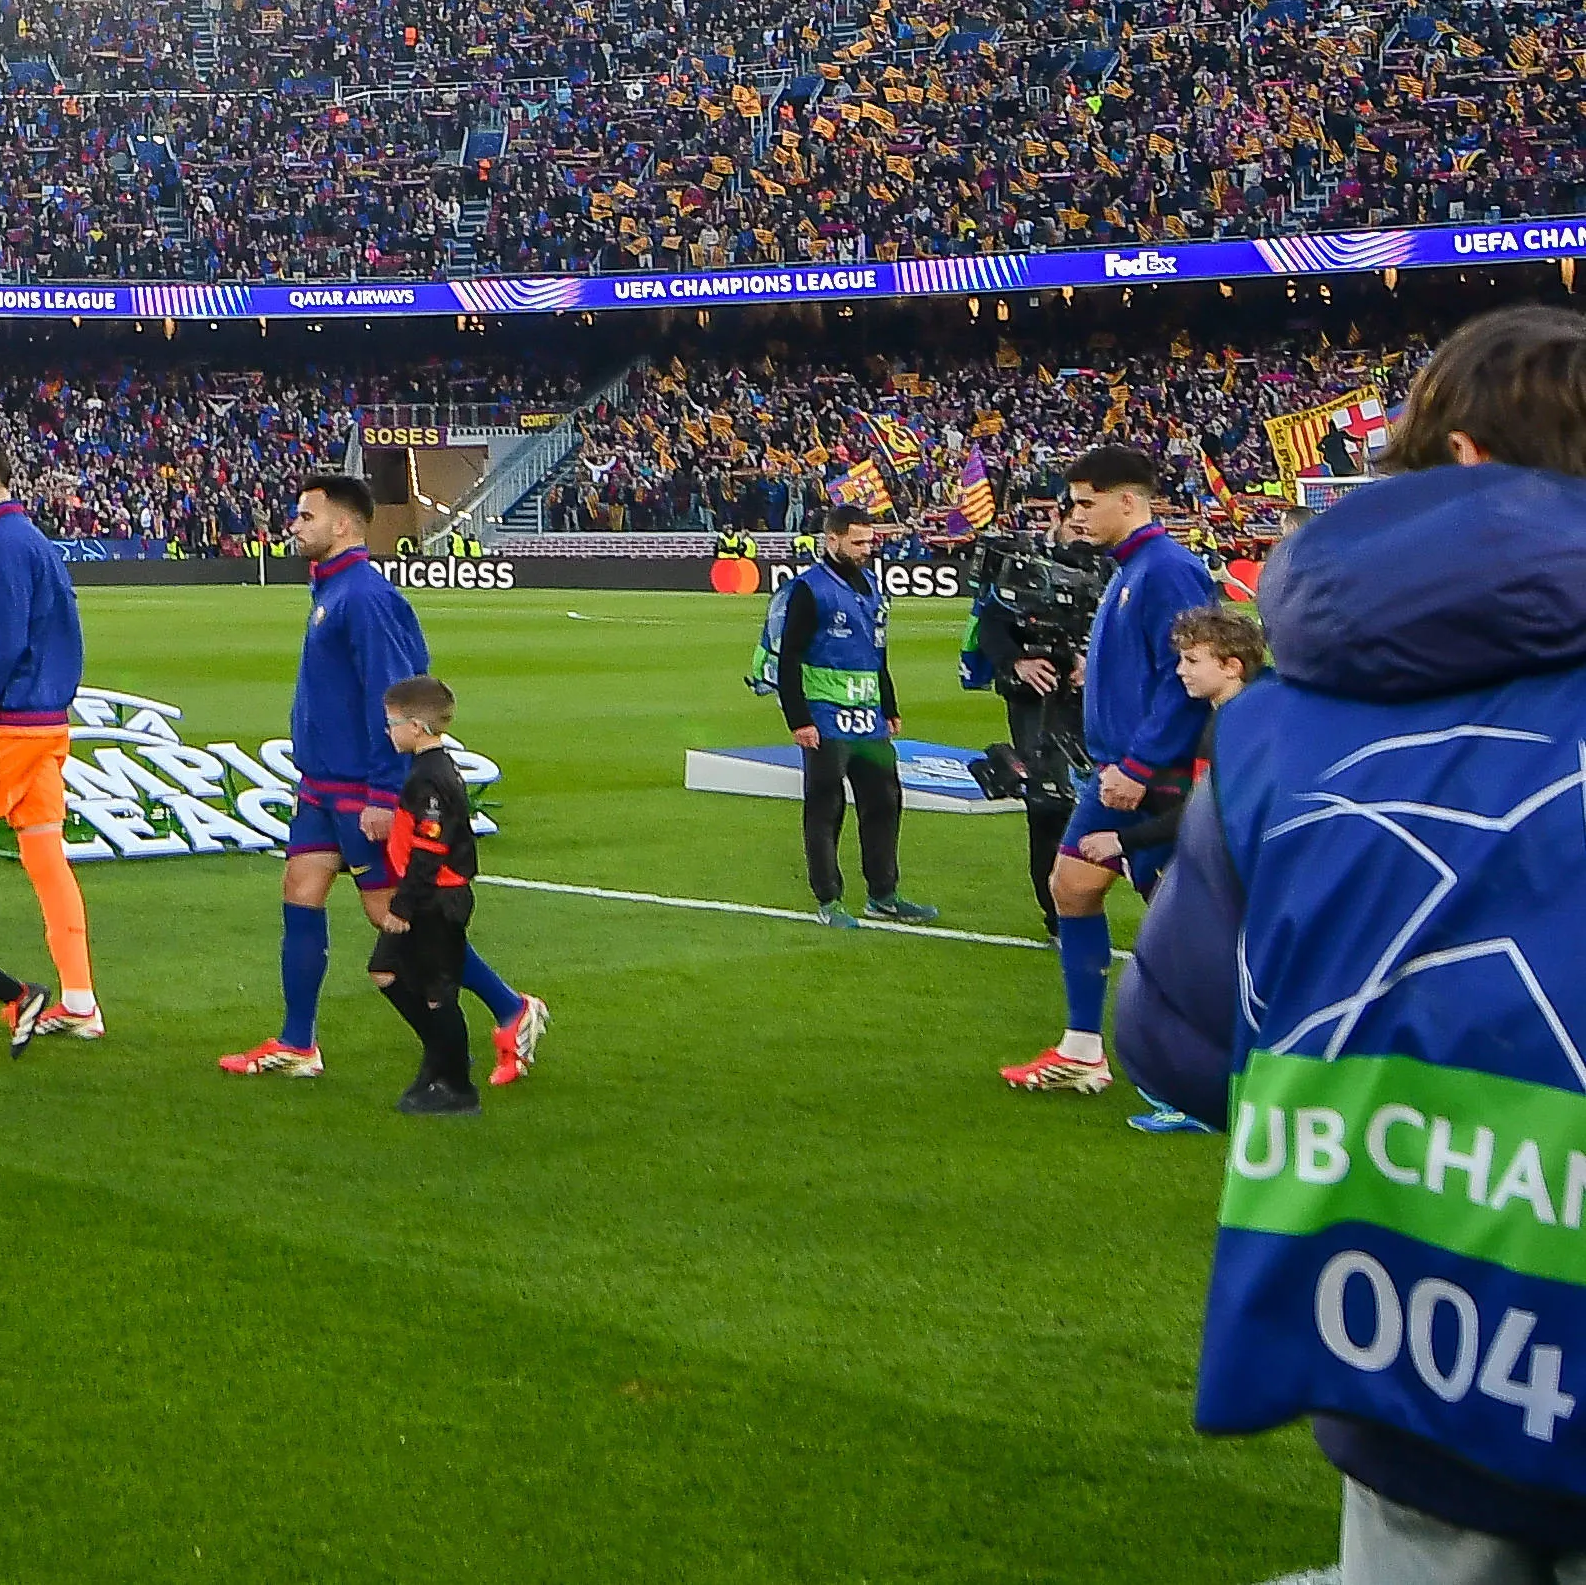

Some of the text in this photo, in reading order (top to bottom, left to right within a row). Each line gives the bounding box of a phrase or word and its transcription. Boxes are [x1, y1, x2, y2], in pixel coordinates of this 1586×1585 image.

[1454, 231, 1519, 254] UEFA
[1104, 251, 1178, 277] FedEx
[614, 270, 877, 299] UEFA CHAMPIONS LEAGUE
[44, 291, 116, 310] LEAGUE
[289, 289, 415, 308] QATAR AIRWAYS
[363, 427, 439, 445] SOSES
[1313, 1248, 1577, 1443] 004
